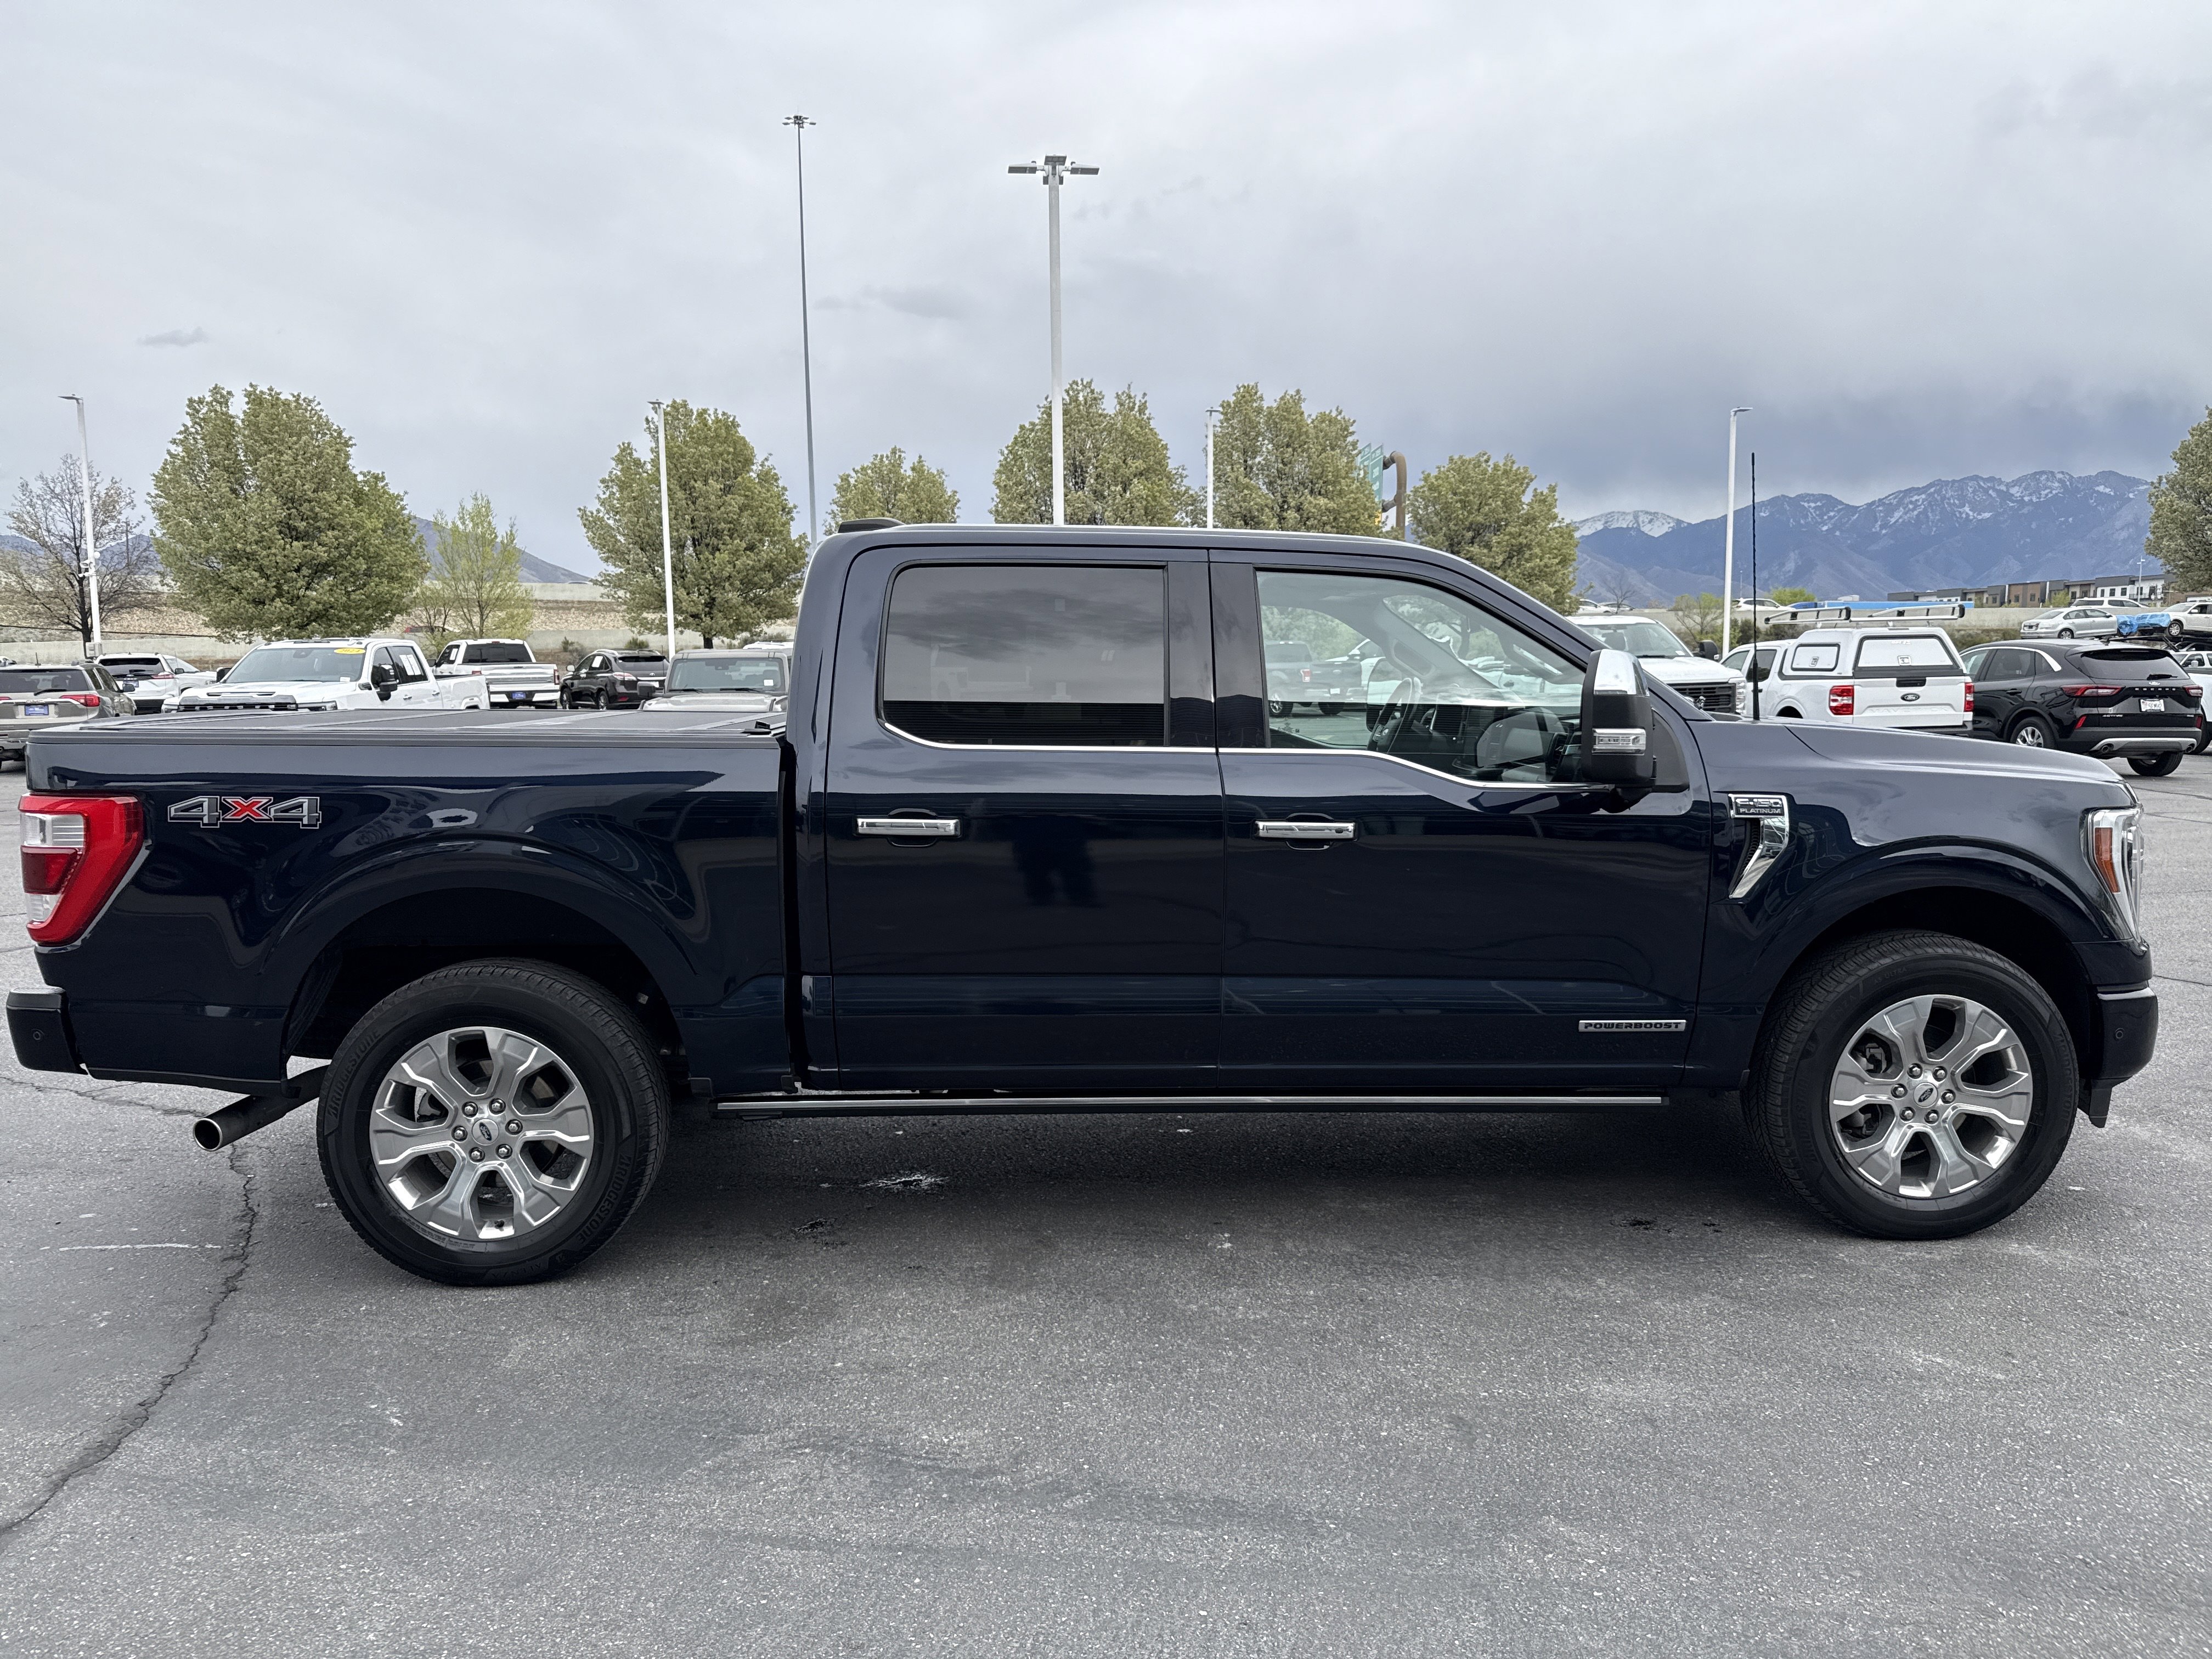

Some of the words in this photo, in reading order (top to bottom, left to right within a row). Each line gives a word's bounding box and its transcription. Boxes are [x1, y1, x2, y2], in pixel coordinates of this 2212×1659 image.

[1735, 798, 1782, 808] F-150
[327, 1028, 381, 1120] BRIDGESTONE
[575, 1153, 631, 1244] BRIDGESTONE
